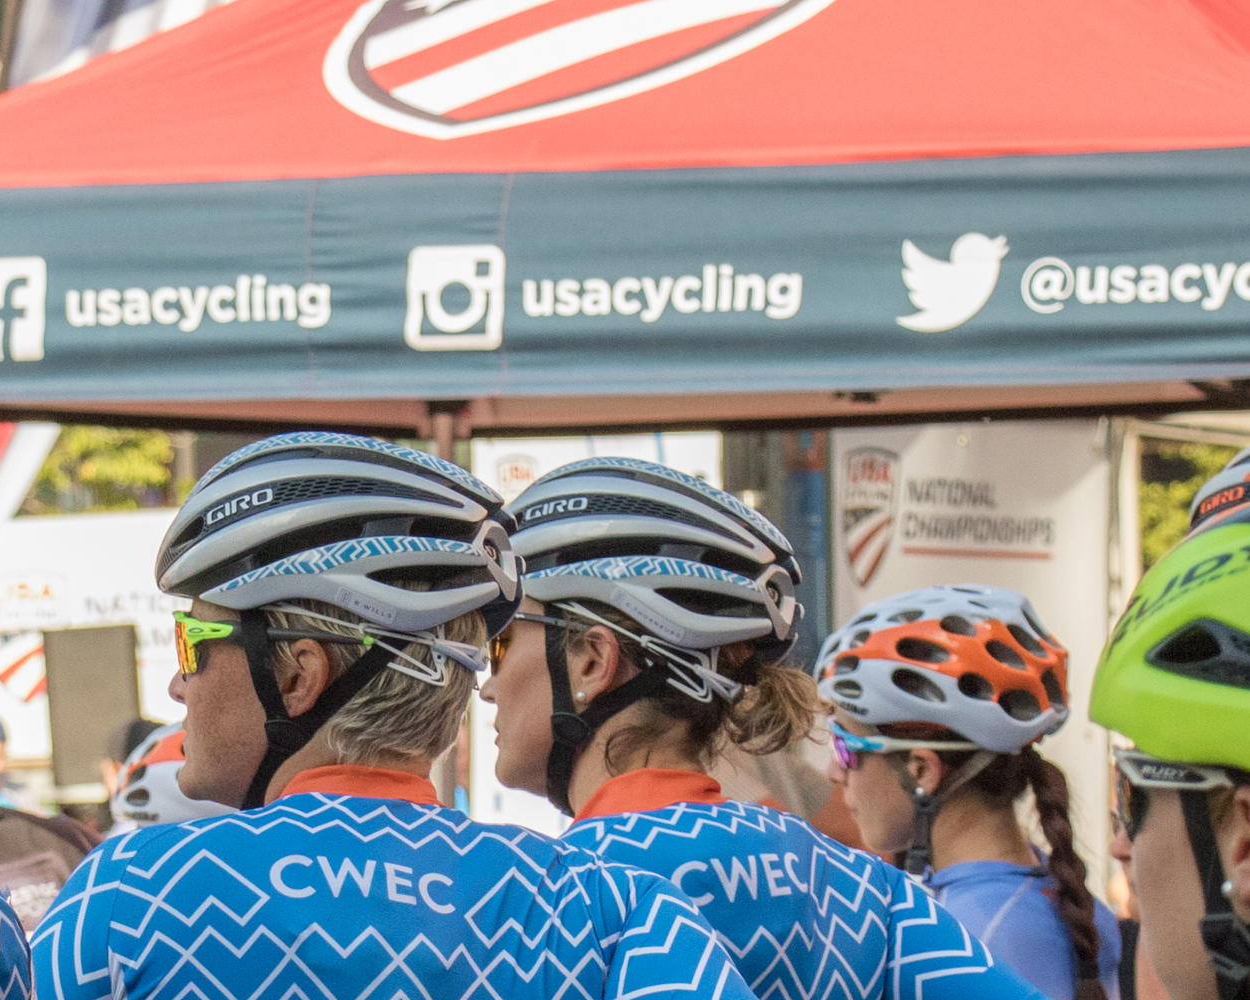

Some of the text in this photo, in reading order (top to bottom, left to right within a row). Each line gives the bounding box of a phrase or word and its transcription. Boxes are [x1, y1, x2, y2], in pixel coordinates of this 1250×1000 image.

[65, 273, 333, 335] usacycling
[521, 263, 804, 323] usacycling
[207, 488, 274, 525] GIRO
[525, 497, 588, 520] GIRO
[906, 477, 997, 509] NATIONAL
[1200, 486, 1246, 514] GIRO
[904, 511, 1055, 545] CHAMPIONSHIPS
[363, 604, 392, 619] WILLS
[268, 854, 456, 915] CWEC
[672, 852, 809, 908] CWEC
